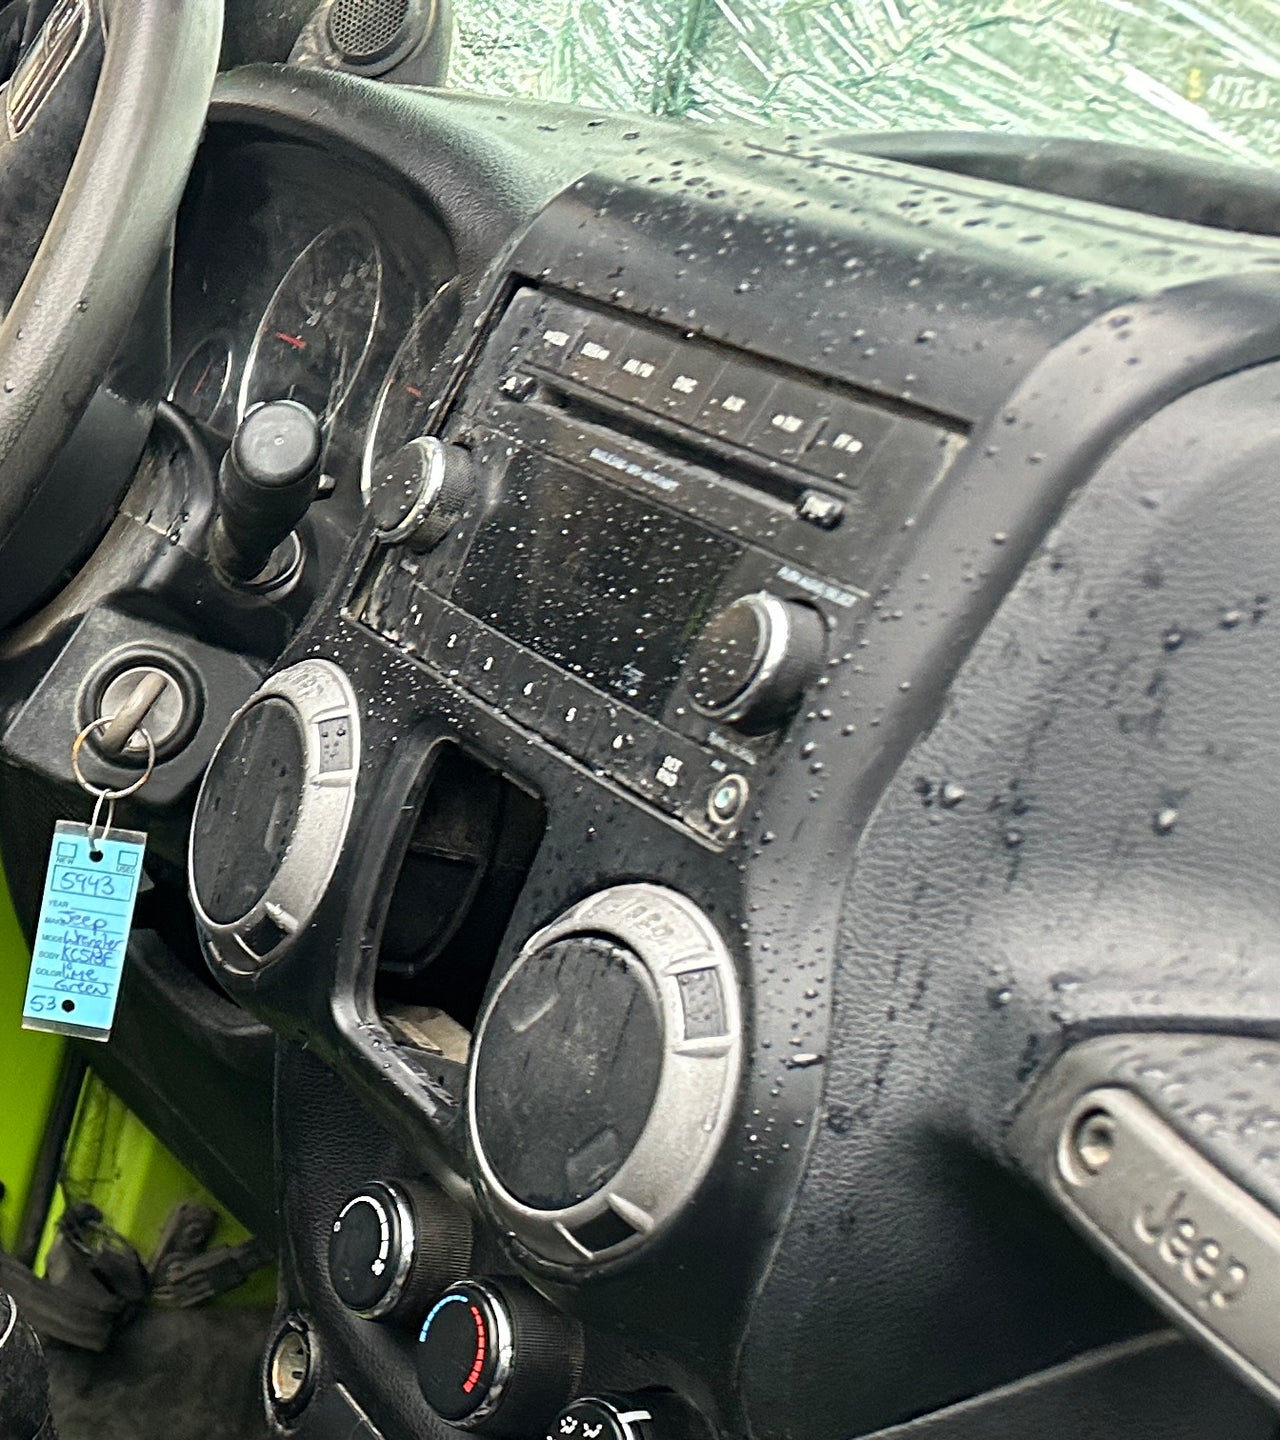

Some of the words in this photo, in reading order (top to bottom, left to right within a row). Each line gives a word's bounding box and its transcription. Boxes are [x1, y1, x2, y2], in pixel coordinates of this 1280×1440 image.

[48, 899, 69, 908] YEAR
[58, 910, 107, 935] Jeep
[30, 994, 57, 1012] 53
[1134, 1190, 1250, 1308] Jeep
